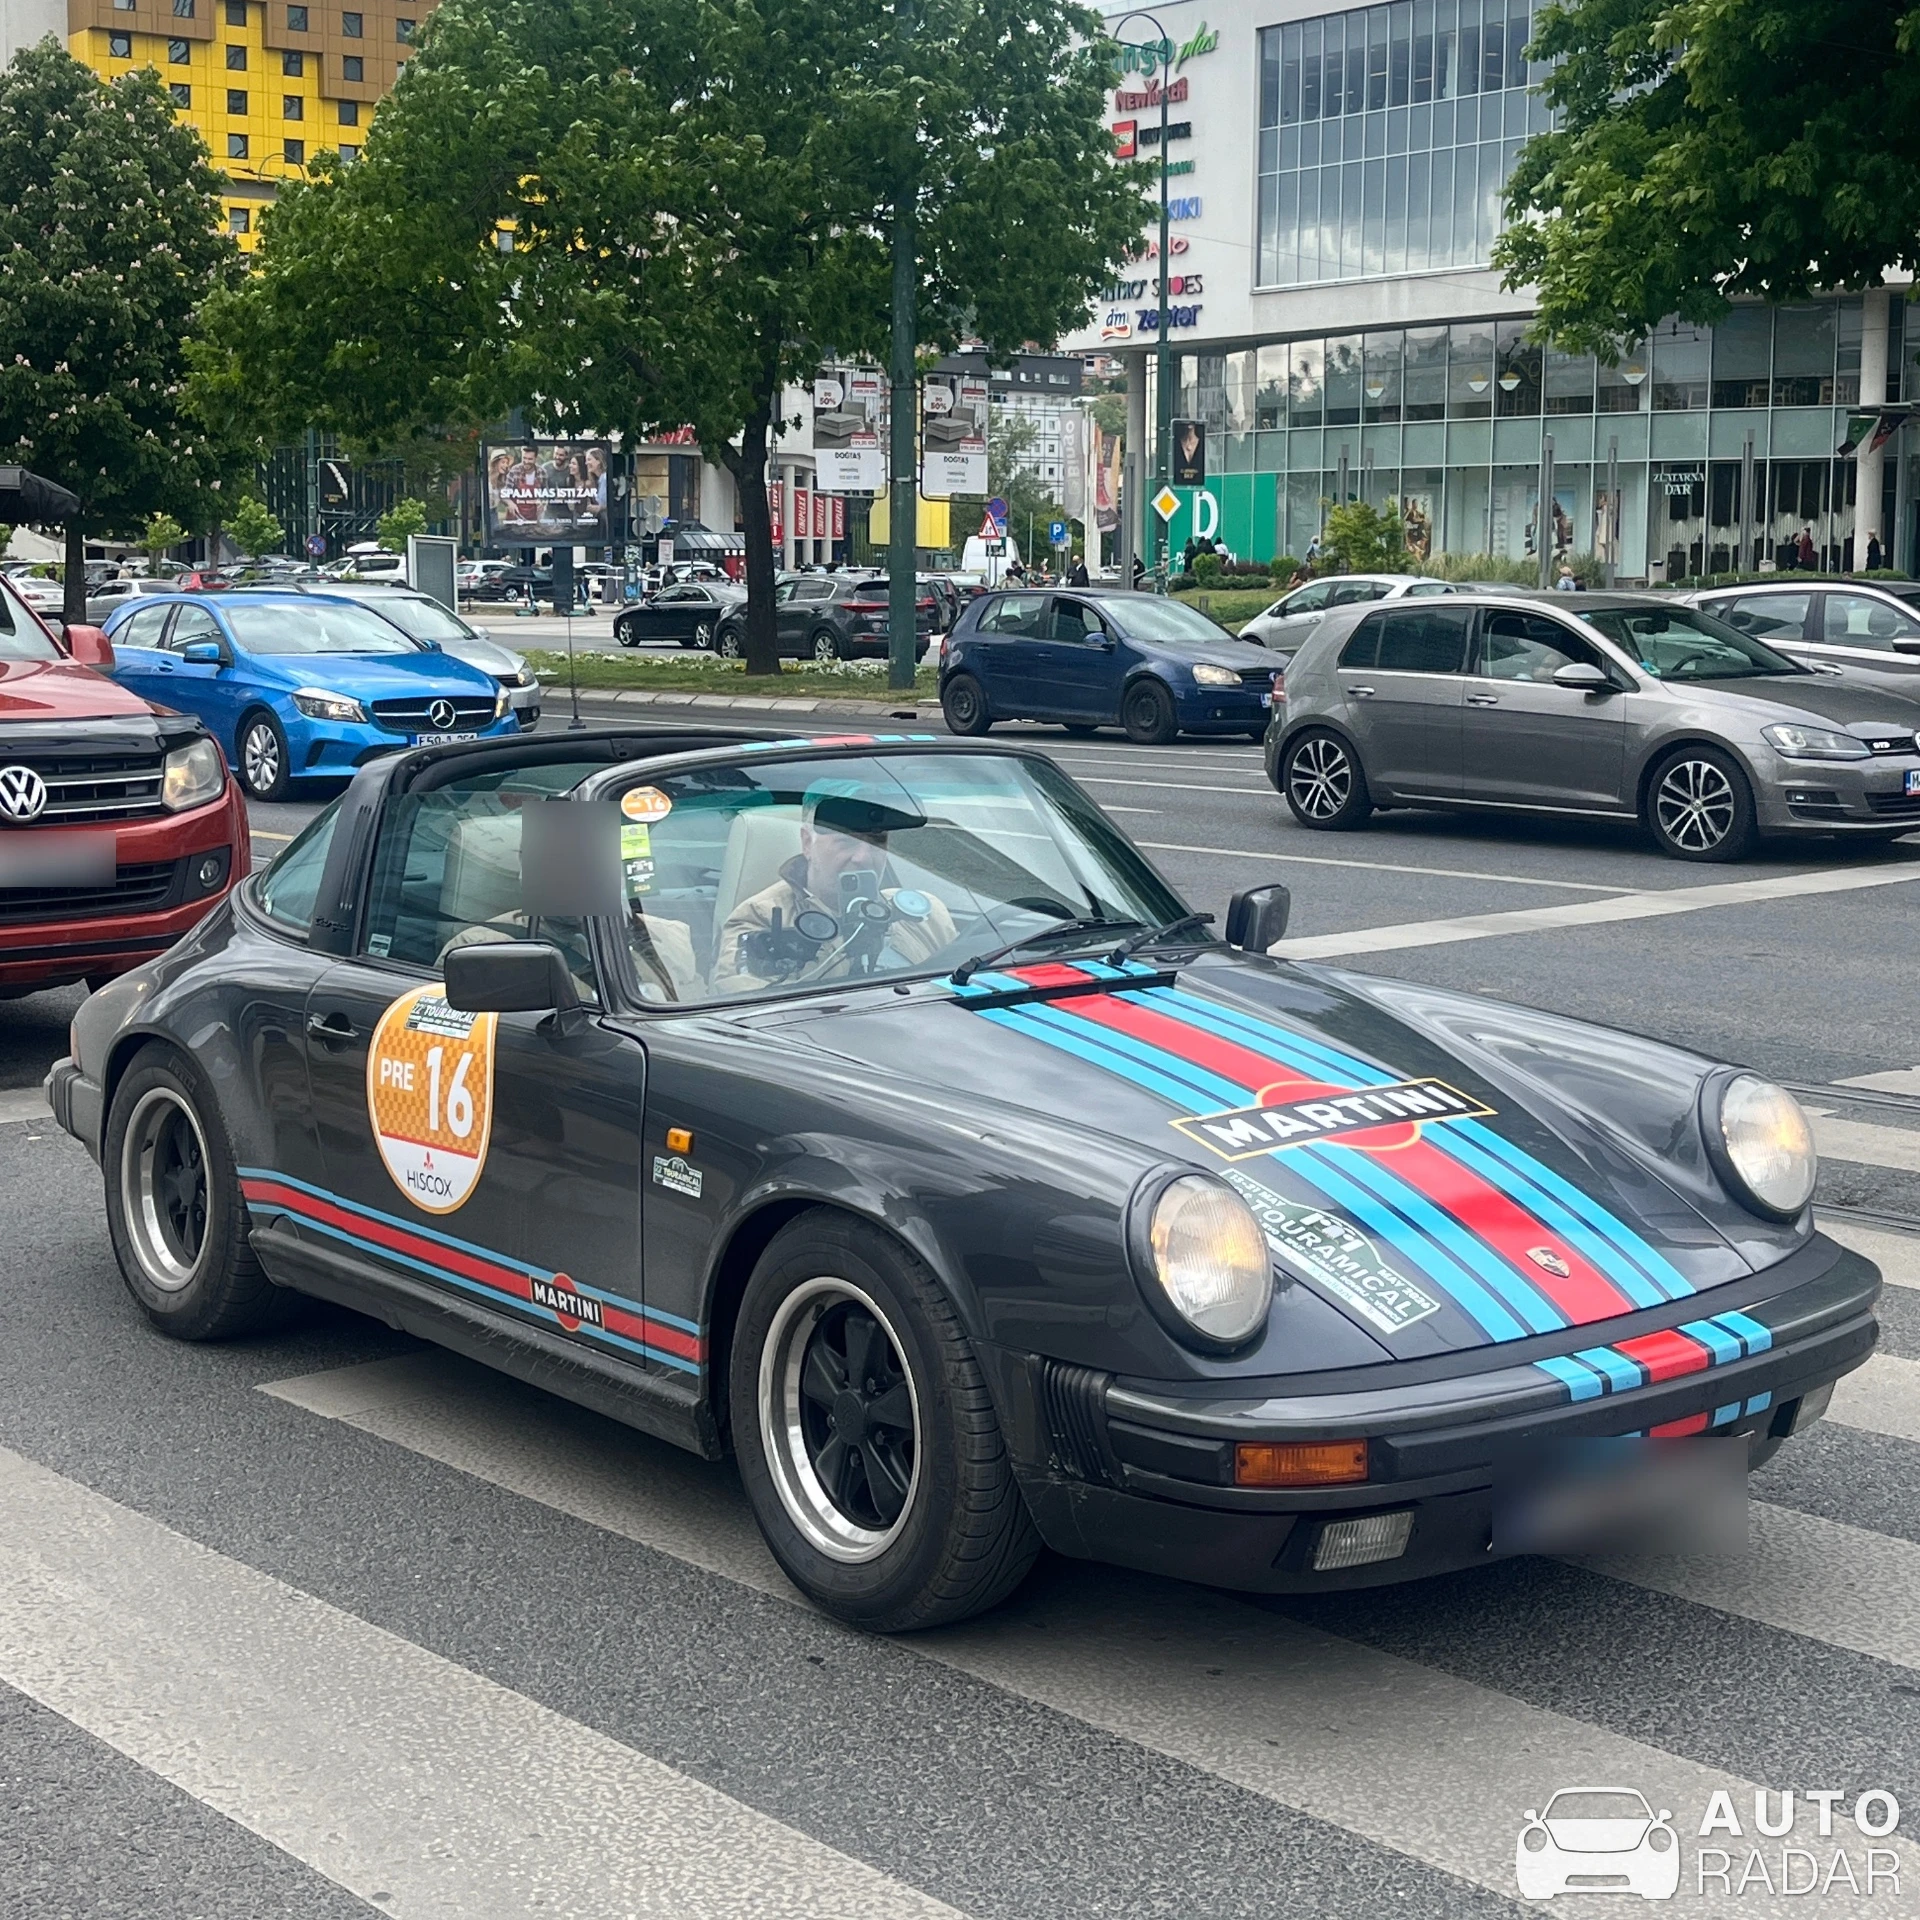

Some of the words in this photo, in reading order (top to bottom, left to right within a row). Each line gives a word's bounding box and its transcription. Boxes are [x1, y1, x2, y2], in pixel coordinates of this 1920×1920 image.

[1175, 21, 1219, 73] plus
[1106, 309, 1127, 328] dm
[820, 397, 836, 405] 50%
[931, 402, 947, 410] 50%
[500, 488, 532, 498] SPAJA
[533, 488, 556, 498] NAS
[557, 488, 575, 498] ISTI
[1664, 483, 1691, 495] DAR
[797, 494, 806, 534] CINEPLEXX
[1193, 491, 1218, 539] D
[1053, 524, 1062, 535] P
[644, 798, 666, 811] 16
[380, 1057, 415, 1091] PRE
[426, 1046, 474, 1138] 16
[1201, 1086, 1467, 1148] MARTINI
[406, 1169, 453, 1198] HISCOX
[1258, 1192, 1287, 1207] MAY
[1250, 1199, 1414, 1318] TOURAMICAL
[1376, 1269, 1405, 1288] MAY
[534, 1282, 599, 1322] MARTINI
